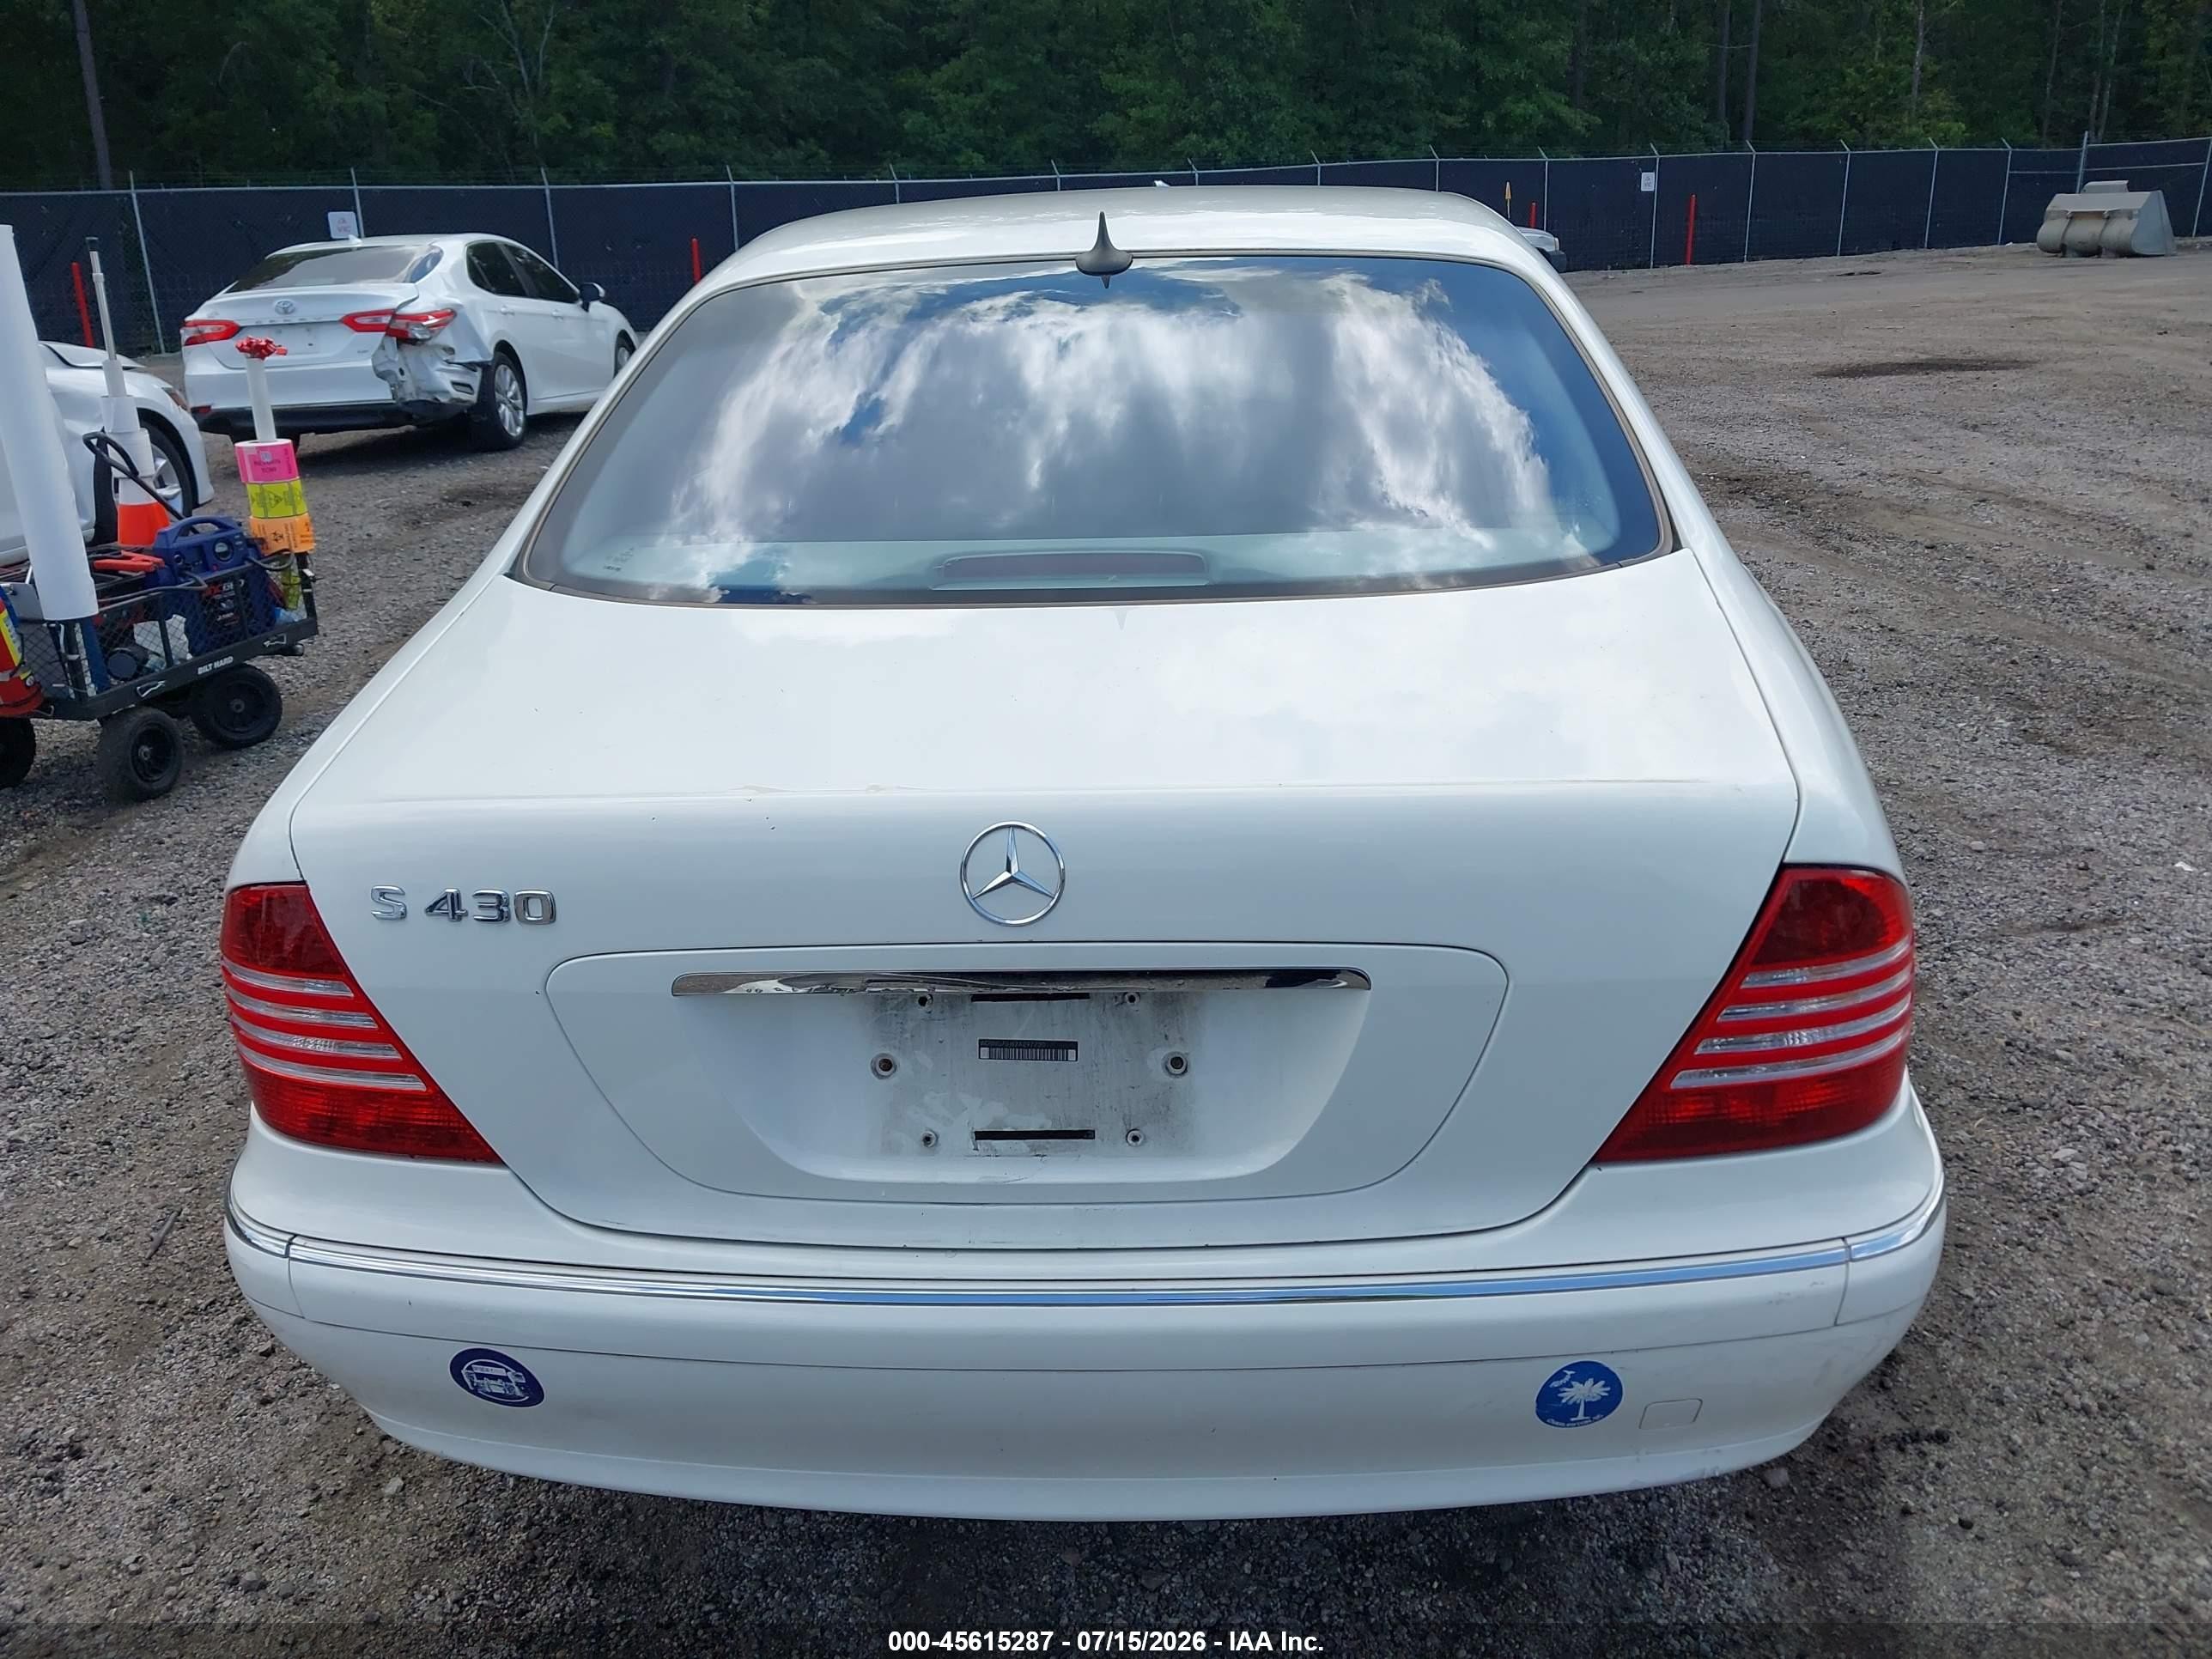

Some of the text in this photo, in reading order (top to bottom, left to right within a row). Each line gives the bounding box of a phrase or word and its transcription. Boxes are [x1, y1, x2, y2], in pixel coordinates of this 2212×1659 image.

[214, 656, 234, 669] HARD
[370, 885, 556, 925] S 430
